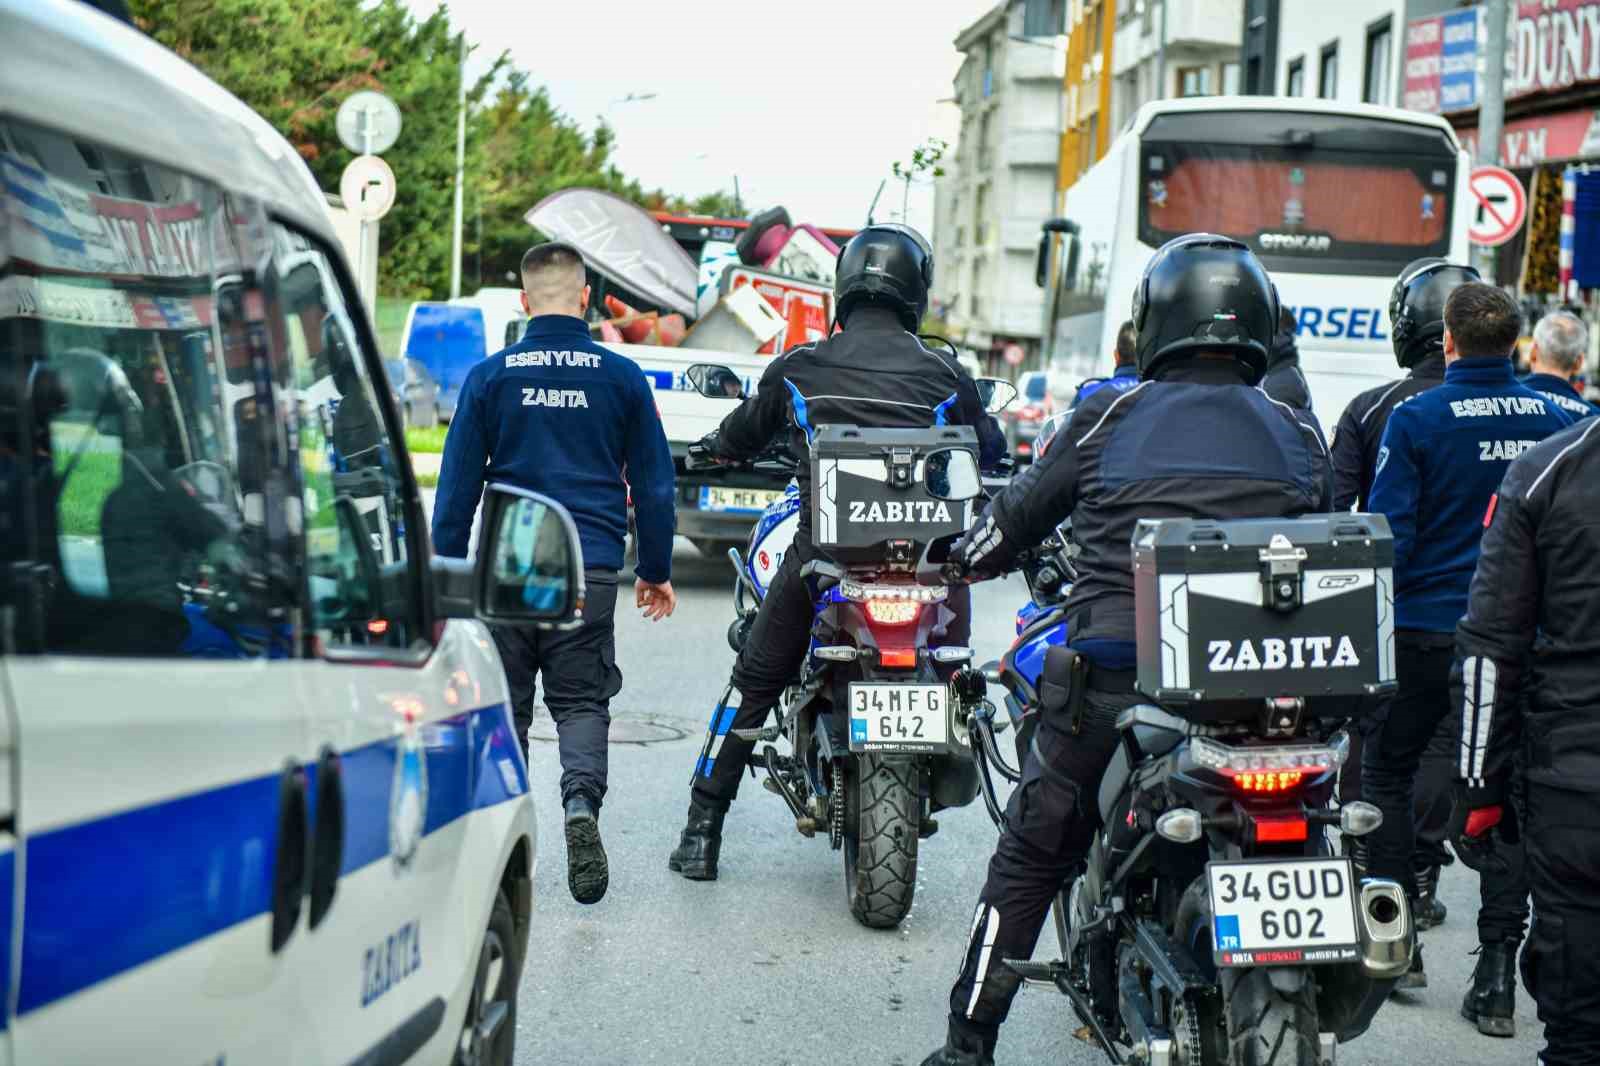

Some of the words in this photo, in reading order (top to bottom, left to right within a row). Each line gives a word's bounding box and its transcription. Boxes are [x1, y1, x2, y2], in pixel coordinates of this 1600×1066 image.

[1259, 233, 1331, 250] OTOKAR
[1290, 306, 1387, 340] RSEL
[505, 350, 602, 368] ESENYURT
[522, 388, 589, 408] ZABITA
[1449, 397, 1547, 418] ESENYURT
[1478, 439, 1542, 462] ZABIT
[849, 501, 952, 522] ZABITA
[1207, 635, 1361, 672] ZABITA
[880, 716, 924, 738] 642
[1221, 935, 1238, 949] TR
[1260, 908, 1325, 940] 602
